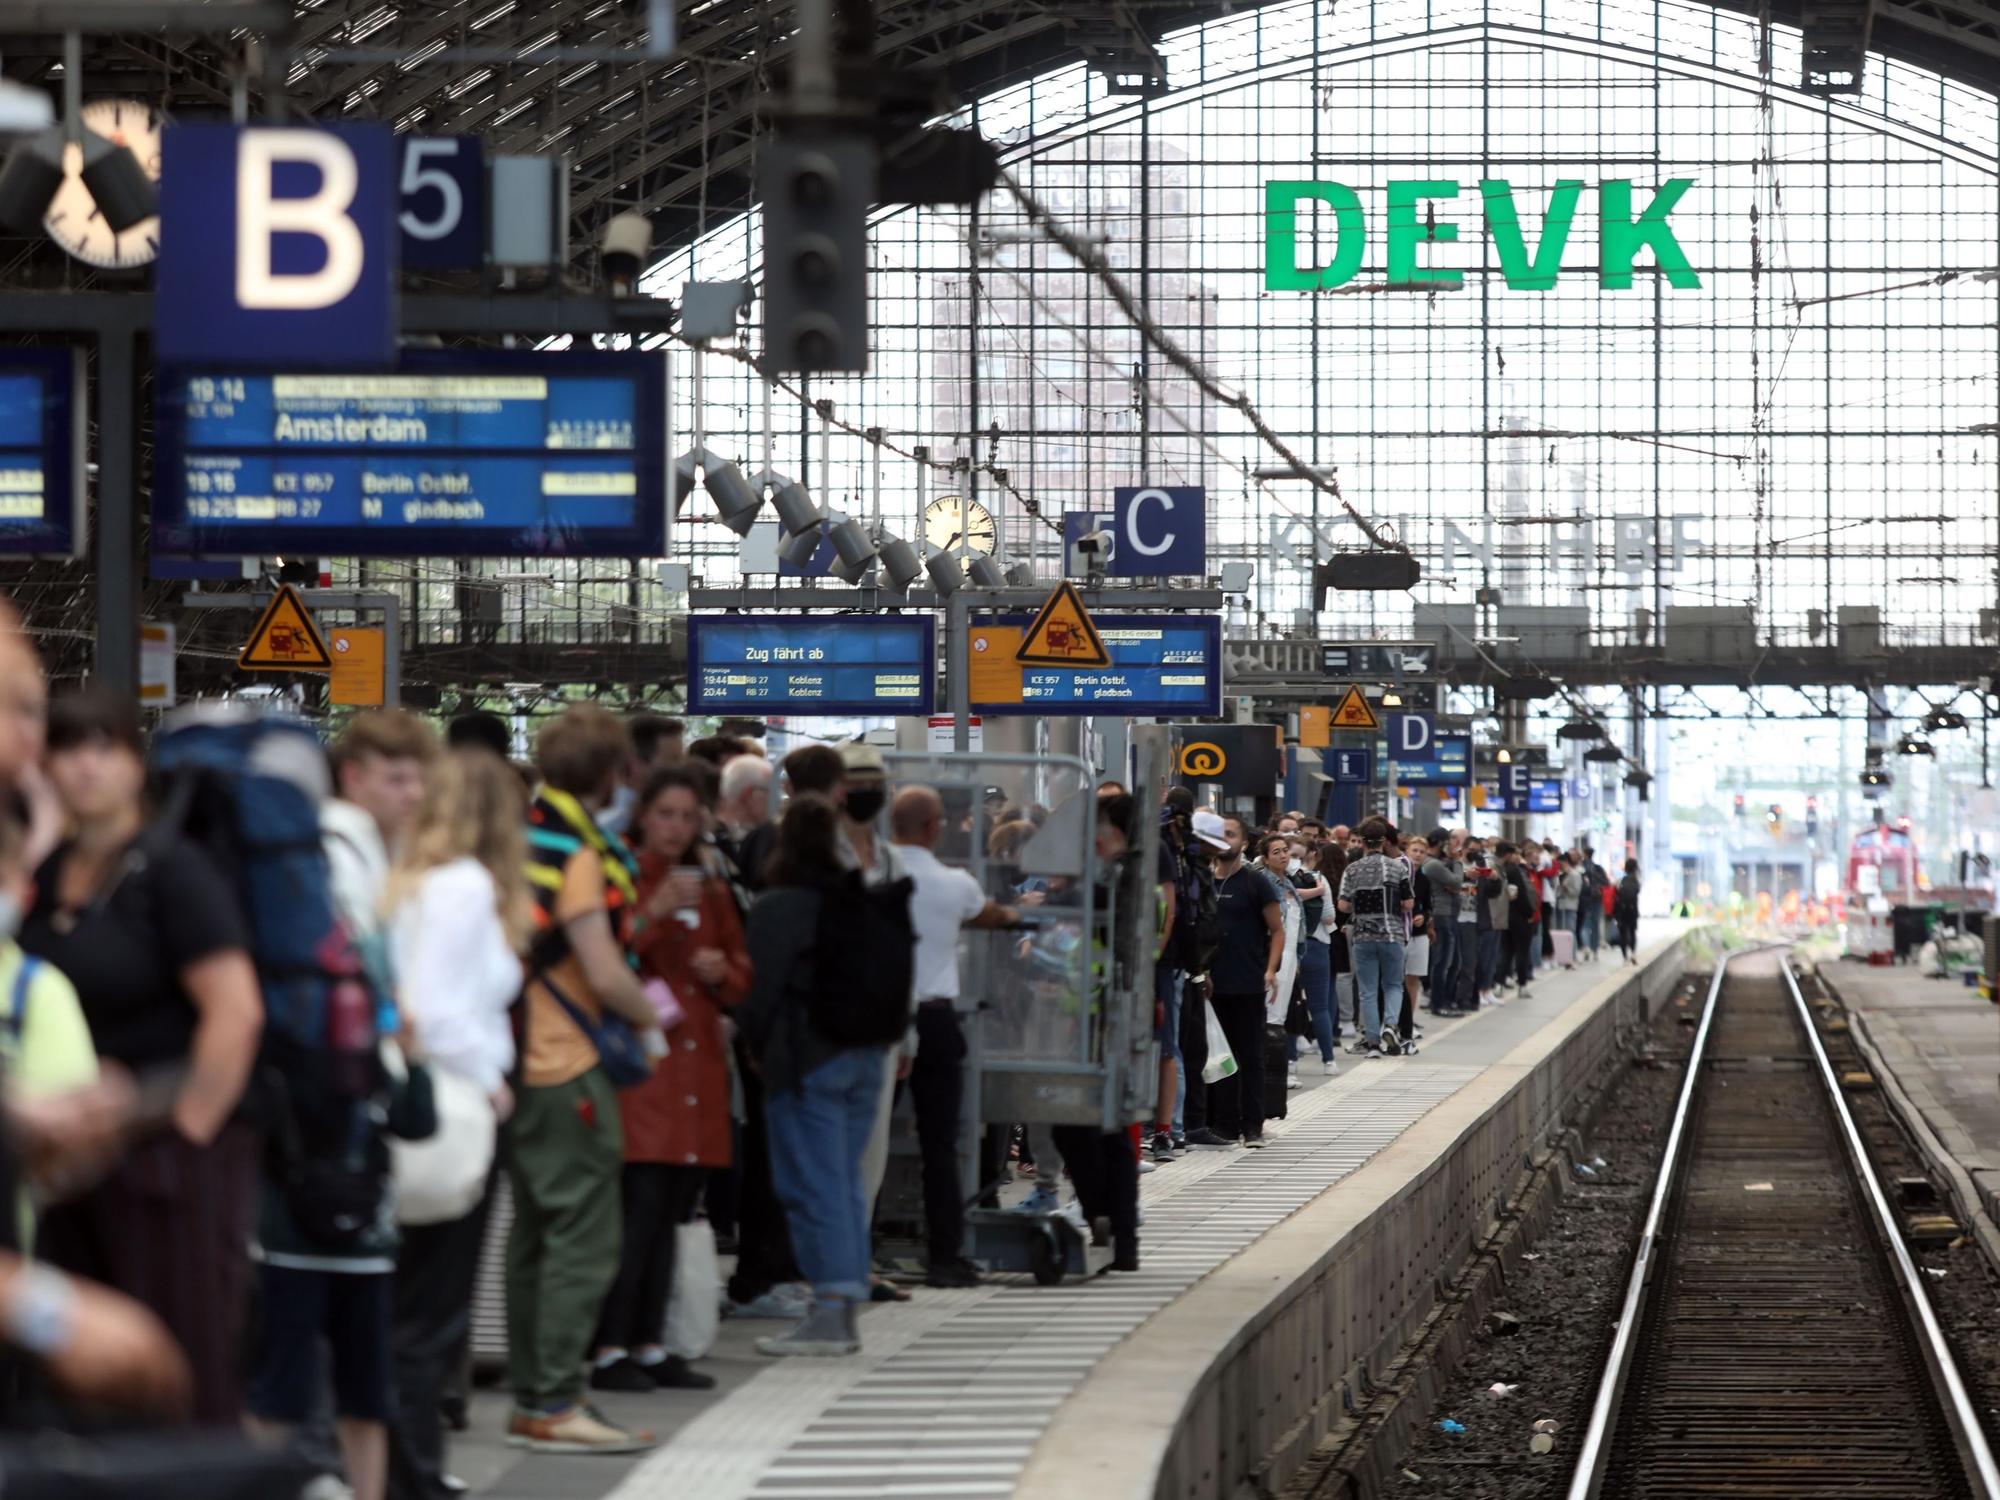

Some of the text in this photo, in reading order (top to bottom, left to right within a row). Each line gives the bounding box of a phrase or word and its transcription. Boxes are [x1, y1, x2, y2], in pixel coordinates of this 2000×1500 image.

[399, 138, 463, 240] 5
[234, 126, 365, 310] B
[1265, 178, 1703, 291] DEVK
[274, 412, 428, 442] Amsterdam
[361, 472, 414, 494] Berlin
[362, 498, 382, 518] M
[404, 498, 485, 523] gladbach
[1126, 489, 1175, 556] C
[746, 647, 824, 662] Zug fährt ab
[703, 688, 727, 697] 20:44
[746, 688, 757, 697] RB
[759, 688, 769, 697] 27
[788, 688, 823, 697] Koblenz
[704, 676, 727, 685] 19:44
[746, 676, 757, 685] RB
[759, 676, 769, 685] 27
[788, 676, 823, 685] Koblenz
[1031, 676, 1044, 685] ICE
[1045, 676, 1060, 685] 957
[1074, 676, 1098, 685] Berlin
[1100, 676, 1127, 685] Ostbf.
[1031, 688, 1043, 697] RB
[1044, 688, 1054, 697] 27
[1074, 688, 1083, 697] M
[1094, 688, 1133, 699] gladbach
[1402, 714, 1429, 751] D
[1510, 765, 1528, 791] E
